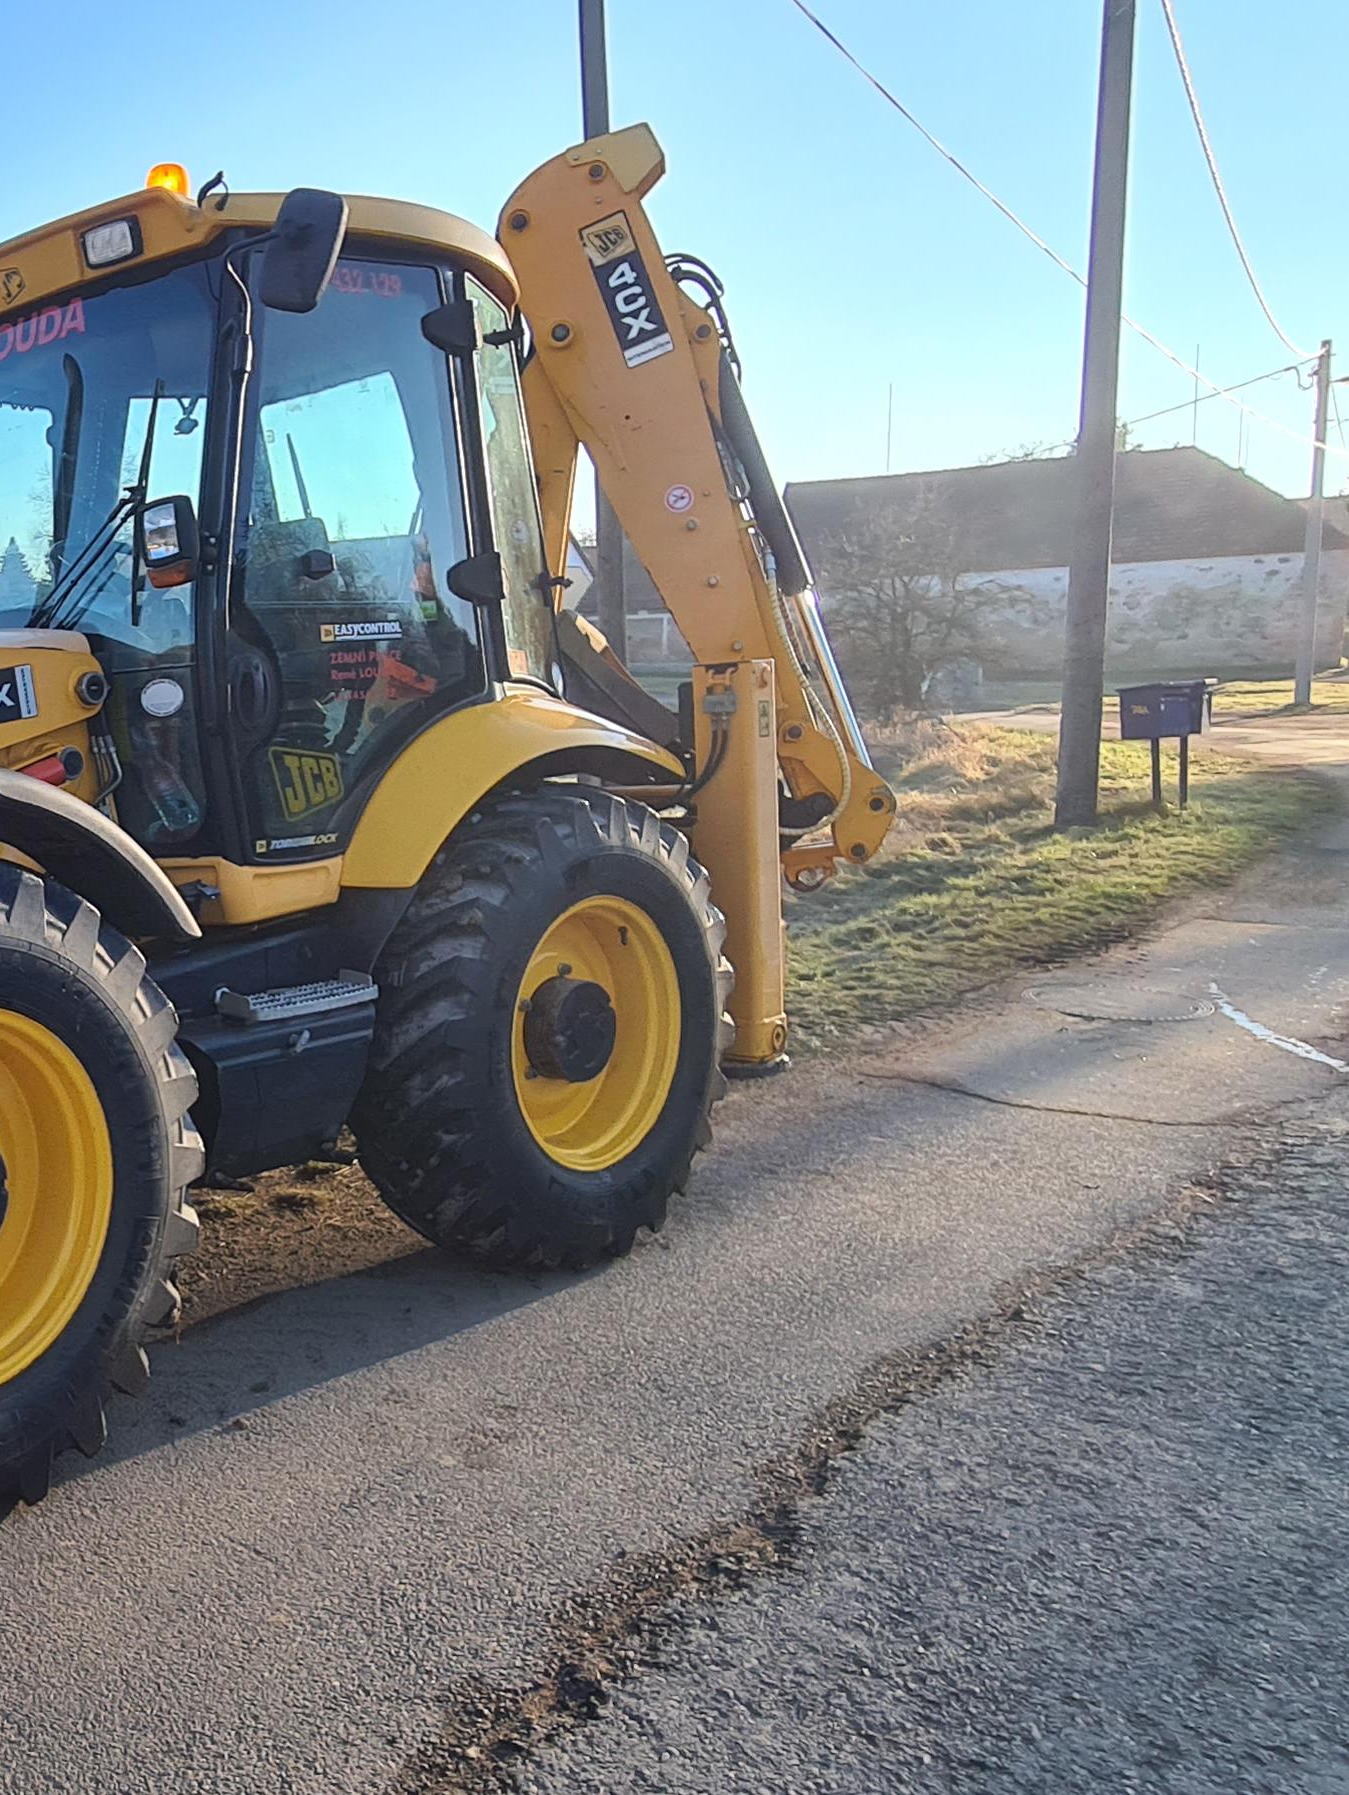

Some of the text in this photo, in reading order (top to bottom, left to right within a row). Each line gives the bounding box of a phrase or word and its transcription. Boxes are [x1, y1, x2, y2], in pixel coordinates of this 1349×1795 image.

[594, 227, 625, 251] JCB
[608, 261, 659, 341] 4CX
[334, 621, 402, 637] EASYCONTROL
[282, 754, 340, 813] JCB
